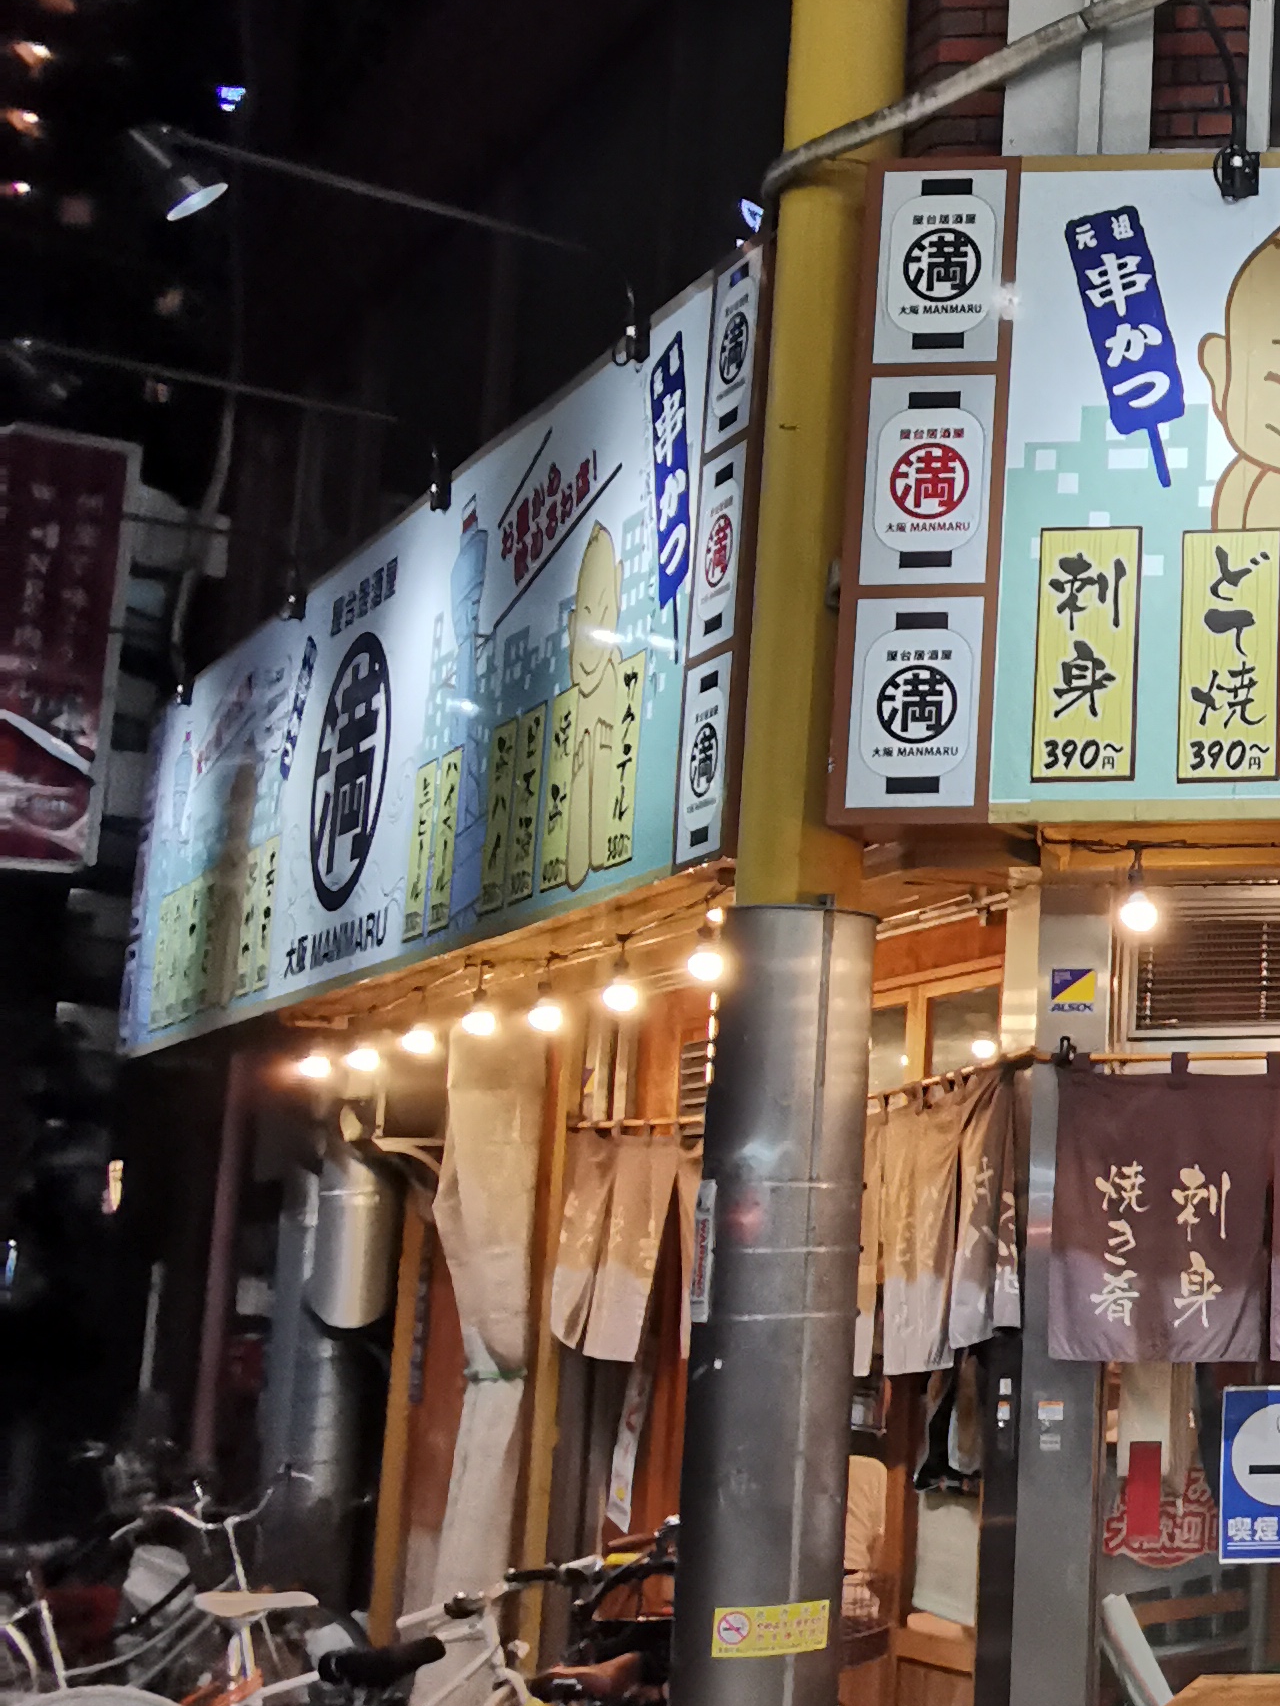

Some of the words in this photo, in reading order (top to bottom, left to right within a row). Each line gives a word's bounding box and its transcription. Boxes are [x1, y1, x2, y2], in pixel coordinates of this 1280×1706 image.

[903, 228, 981, 302] 満
[1074, 217, 1134, 249] 元祖
[922, 304, 982, 315] MANMARU
[1084, 254, 1169, 408] 串かつ
[654, 388, 687, 577] 串かつ
[889, 442, 969, 520] 満
[910, 521, 971, 534] MANMARU
[1051, 550, 1125, 718] 刺身
[1193, 545, 1270, 730] どて焼
[876, 665, 957, 743] 満
[309, 631, 392, 912] 満
[896, 746, 959, 759] MANMARU
[1091, 1160, 1152, 1327] 焼き肴
[1172, 1164, 1230, 1329] 刺身
[1227, 1516, 1279, 1541] 喫煙
